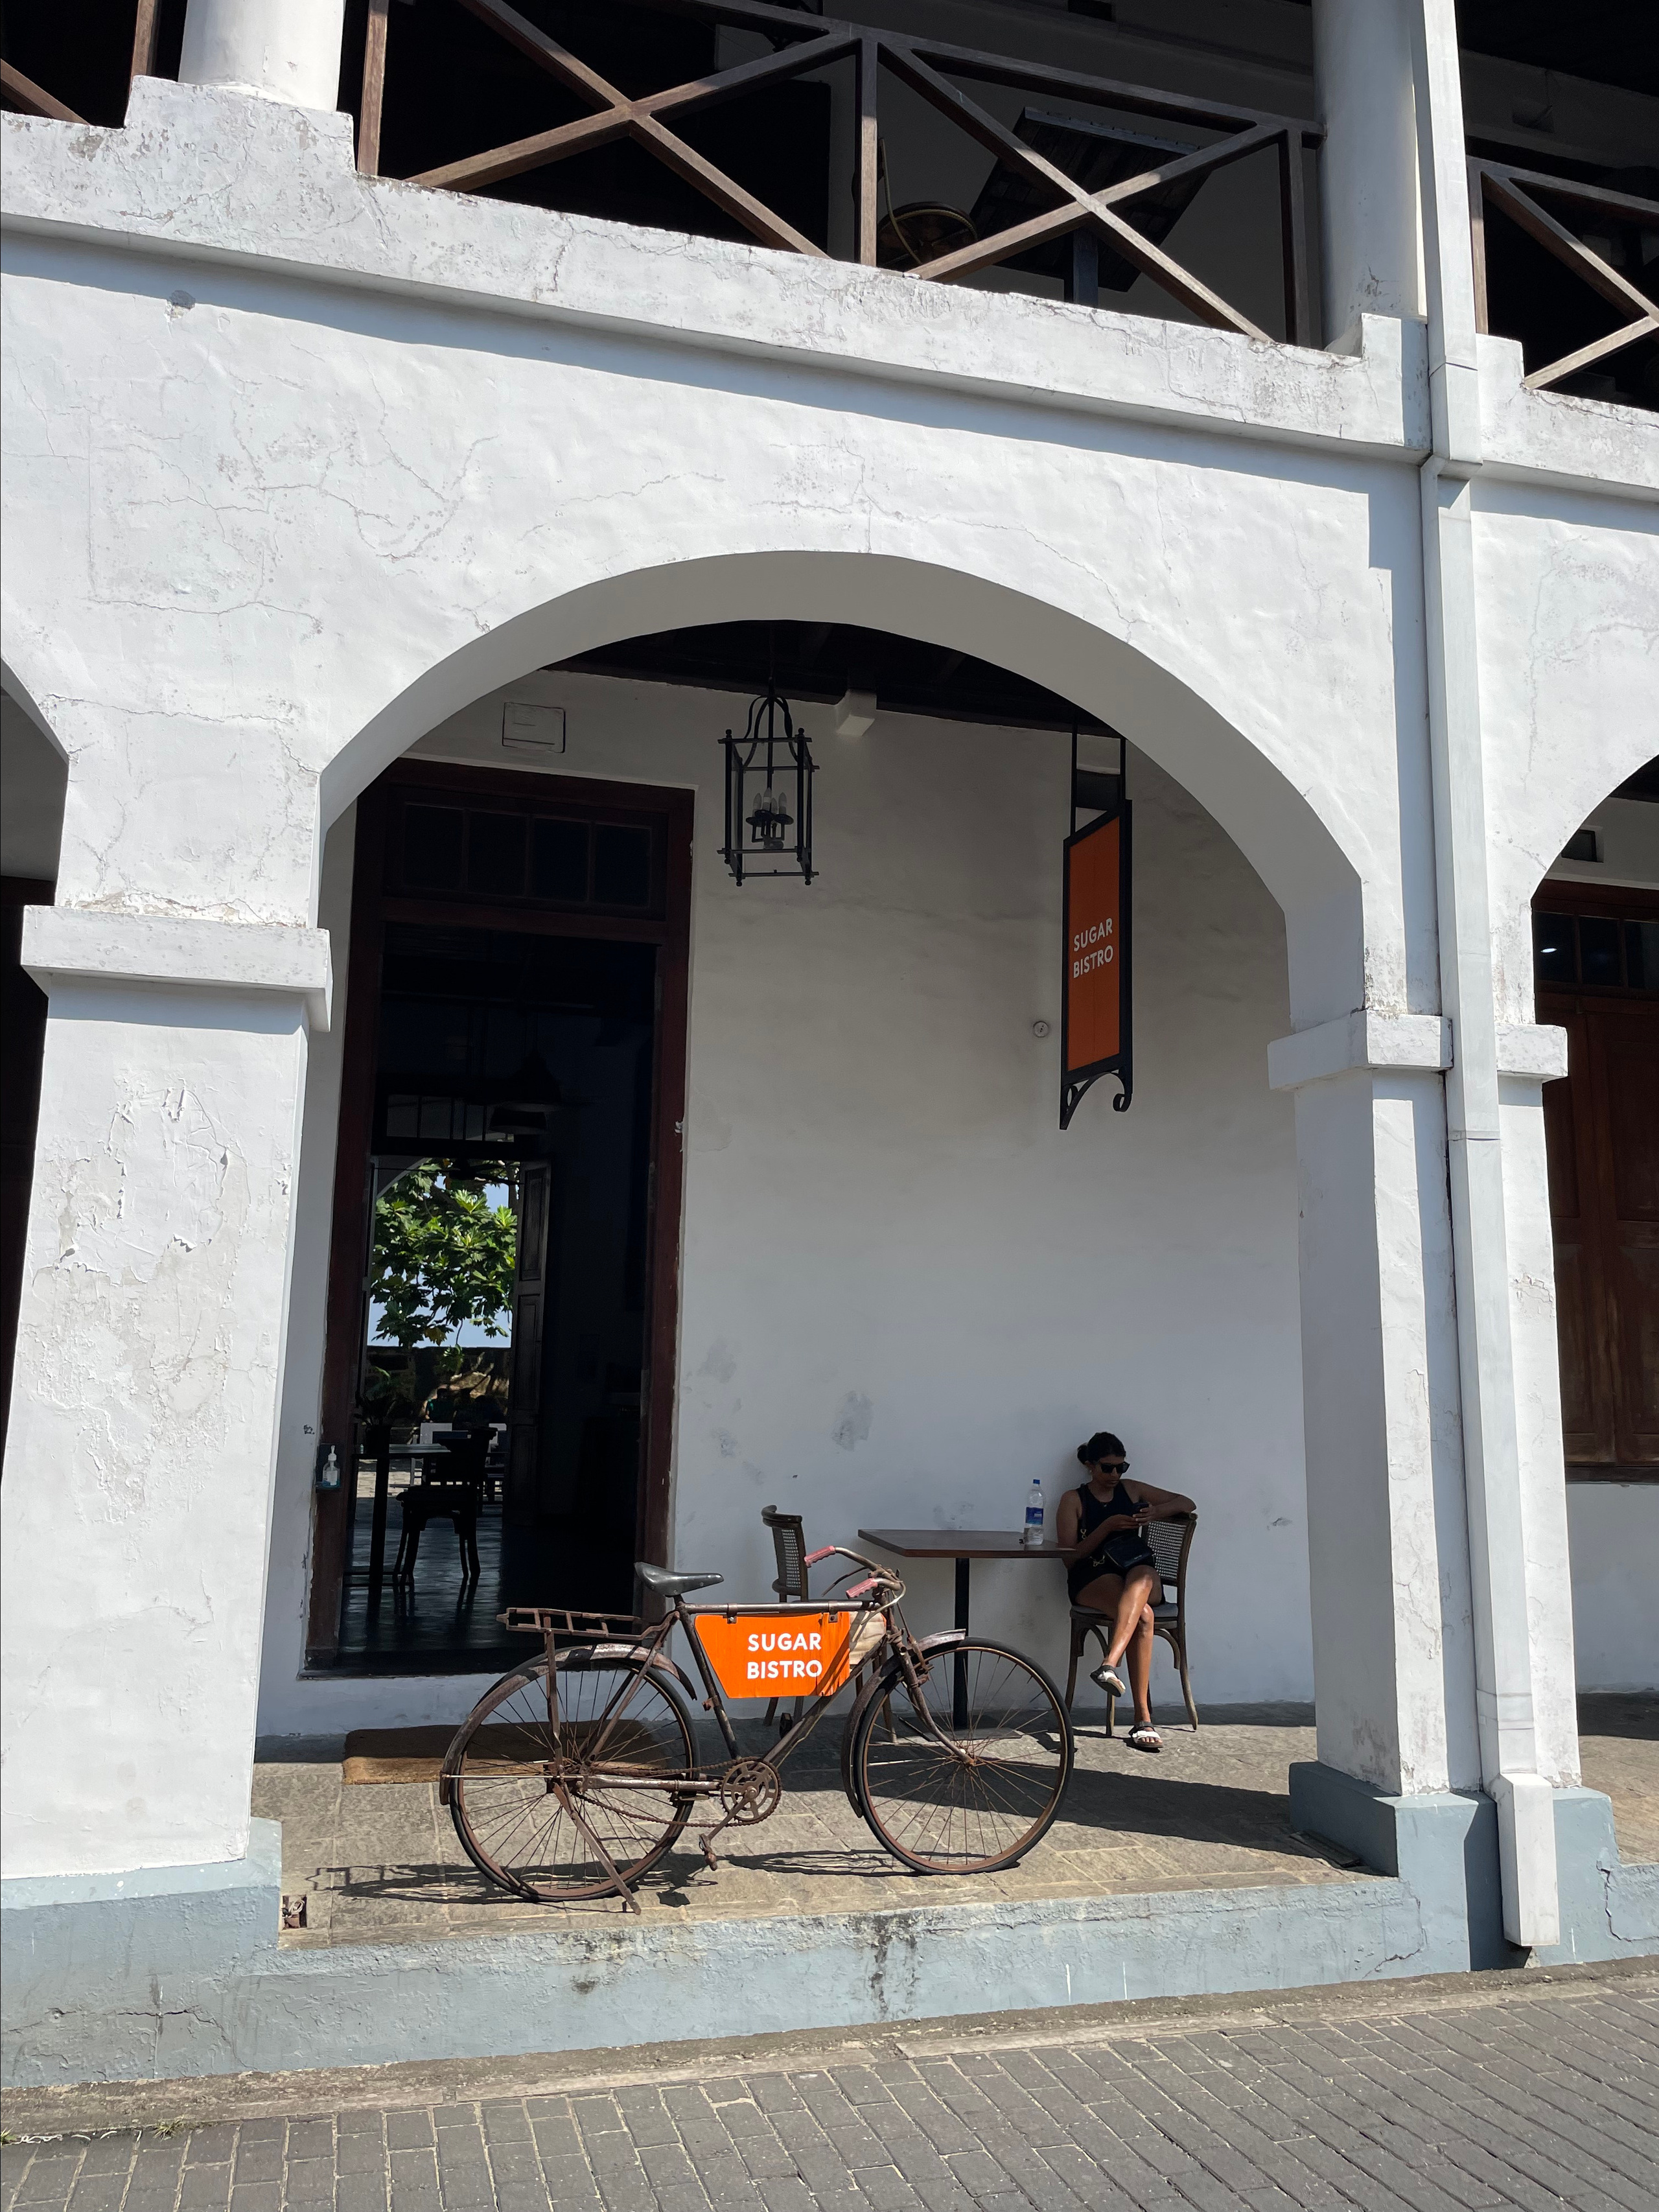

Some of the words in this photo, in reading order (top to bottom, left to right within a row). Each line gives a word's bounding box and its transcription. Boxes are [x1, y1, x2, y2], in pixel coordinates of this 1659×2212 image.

[1073, 918, 1113, 951] SUGAR
[1073, 945, 1113, 979] BISTRO
[748, 1633, 821, 1651] SUGAR
[747, 1659, 822, 1679] BISTRO
